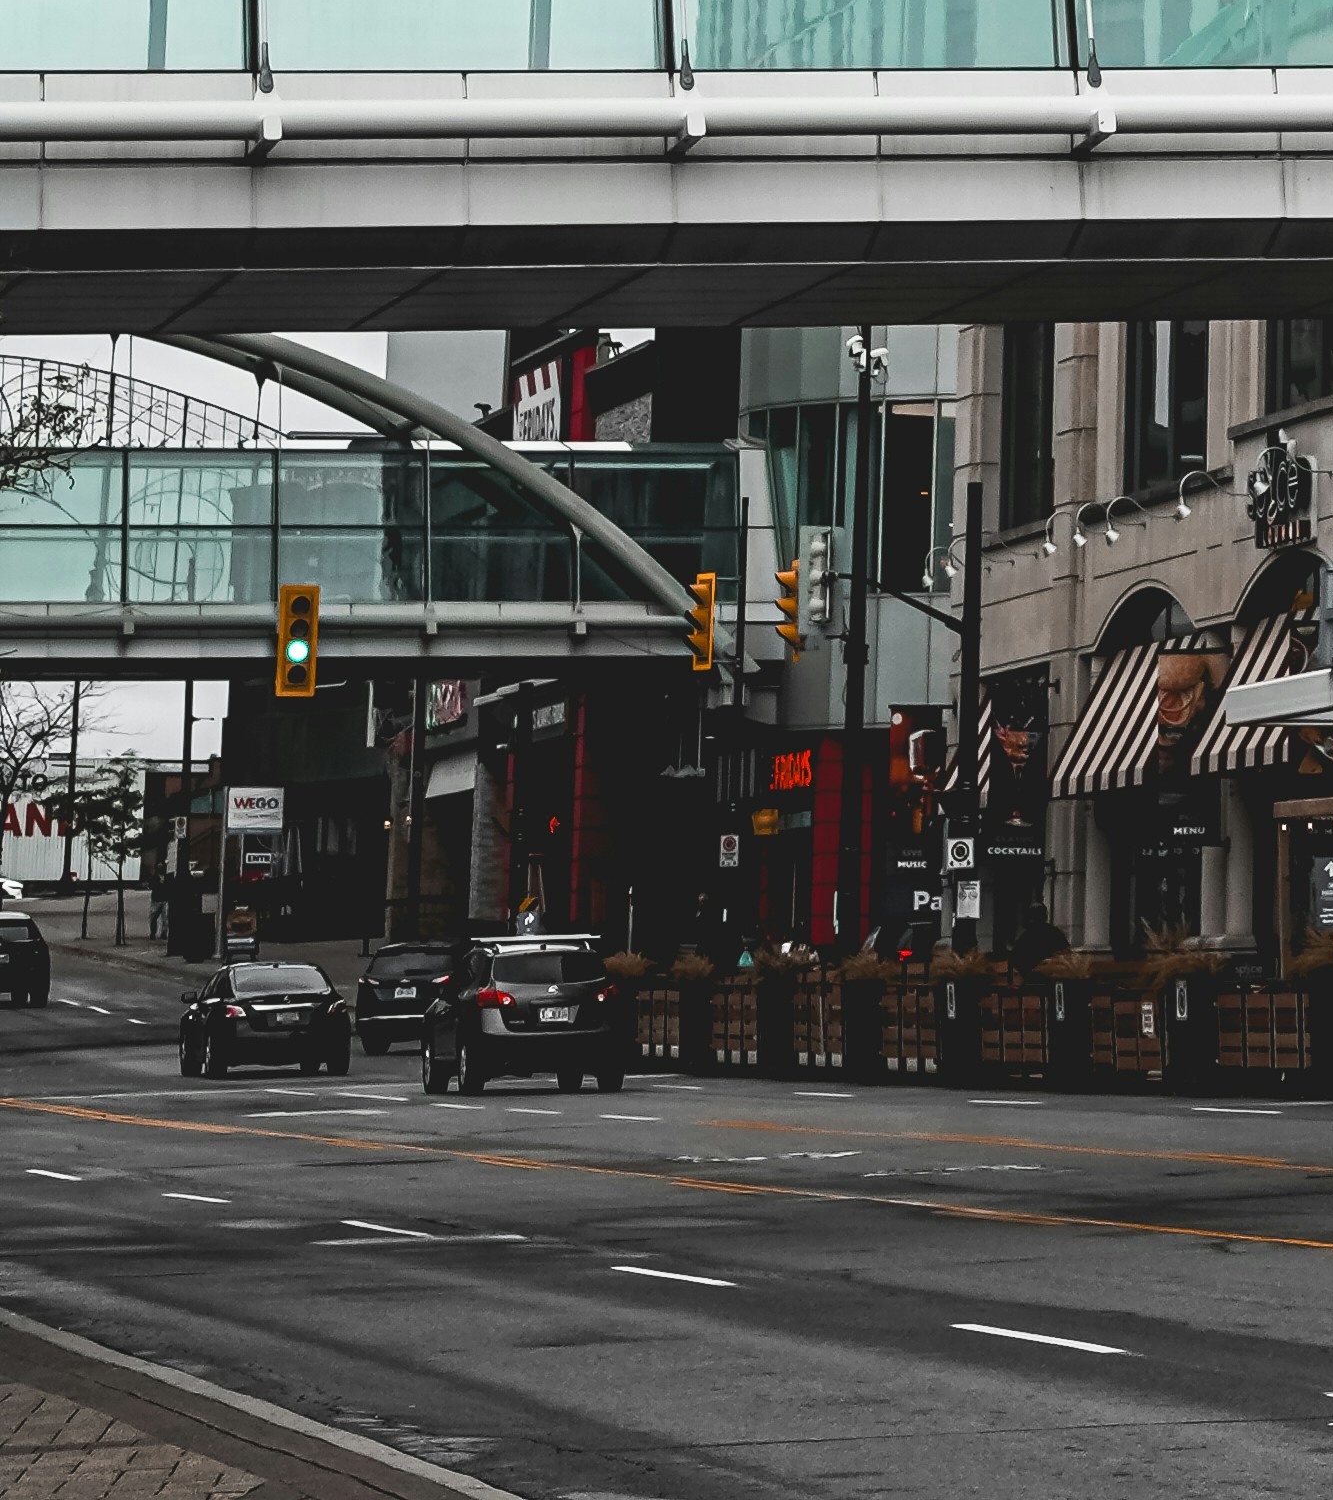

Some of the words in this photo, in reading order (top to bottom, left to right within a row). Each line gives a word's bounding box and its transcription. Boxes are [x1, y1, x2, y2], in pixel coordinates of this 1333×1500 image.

[233, 796, 280, 809] WEGO
[1173, 826, 1206, 835] MENU
[987, 846, 1042, 856] COCKTAILS
[897, 860, 928, 869] MUSIC
